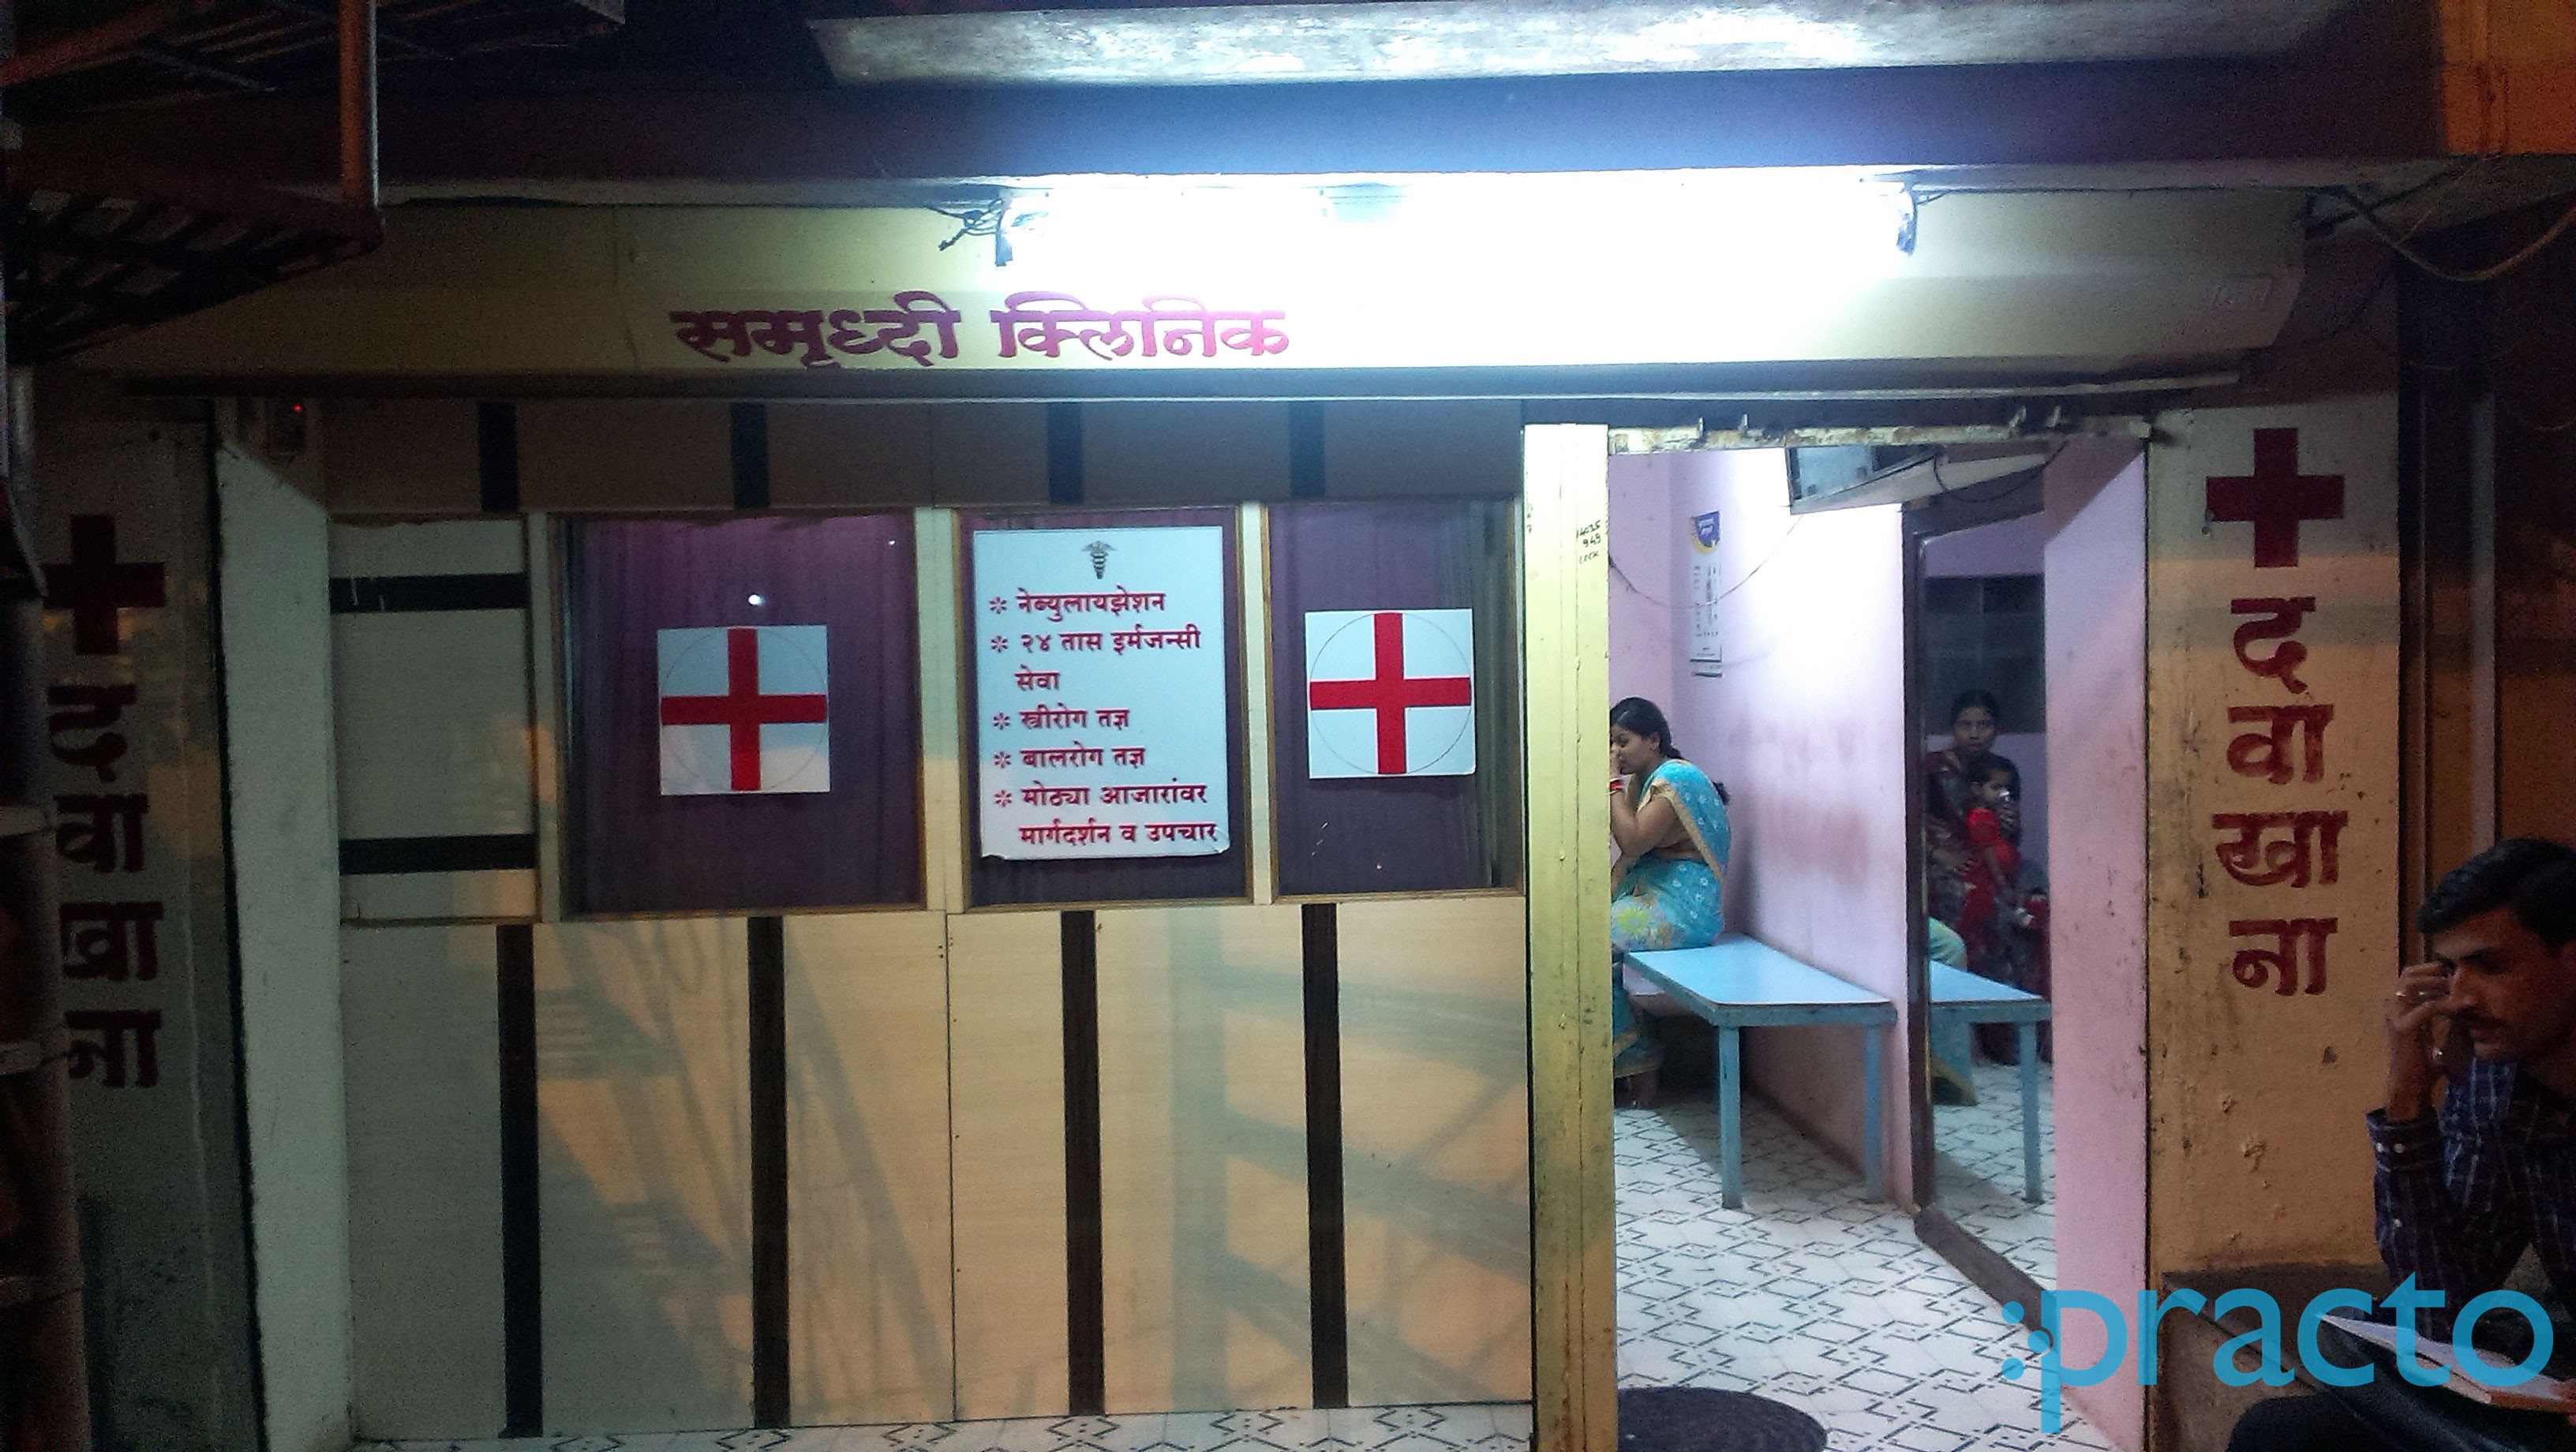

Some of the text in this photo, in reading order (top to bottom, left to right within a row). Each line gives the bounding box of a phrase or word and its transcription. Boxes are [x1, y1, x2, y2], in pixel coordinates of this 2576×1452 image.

[990, 290, 1290, 361] क्लिनिक
[1015, 585, 1166, 622] नेब्युलायझेशन
[1020, 623, 1201, 657] २४ तास इर्मजन्सी
[1014, 664, 1061, 691] सेवा
[1096, 709, 1129, 731] तज्ञ
[1020, 740, 1146, 769] बालरोग तज्ञ
[1020, 777, 1208, 806] मोठ्या आजारांवर
[2211, 596, 2349, 997] दवाखाना
[1018, 817, 1218, 847] मार्गदर्शन व उपचार
